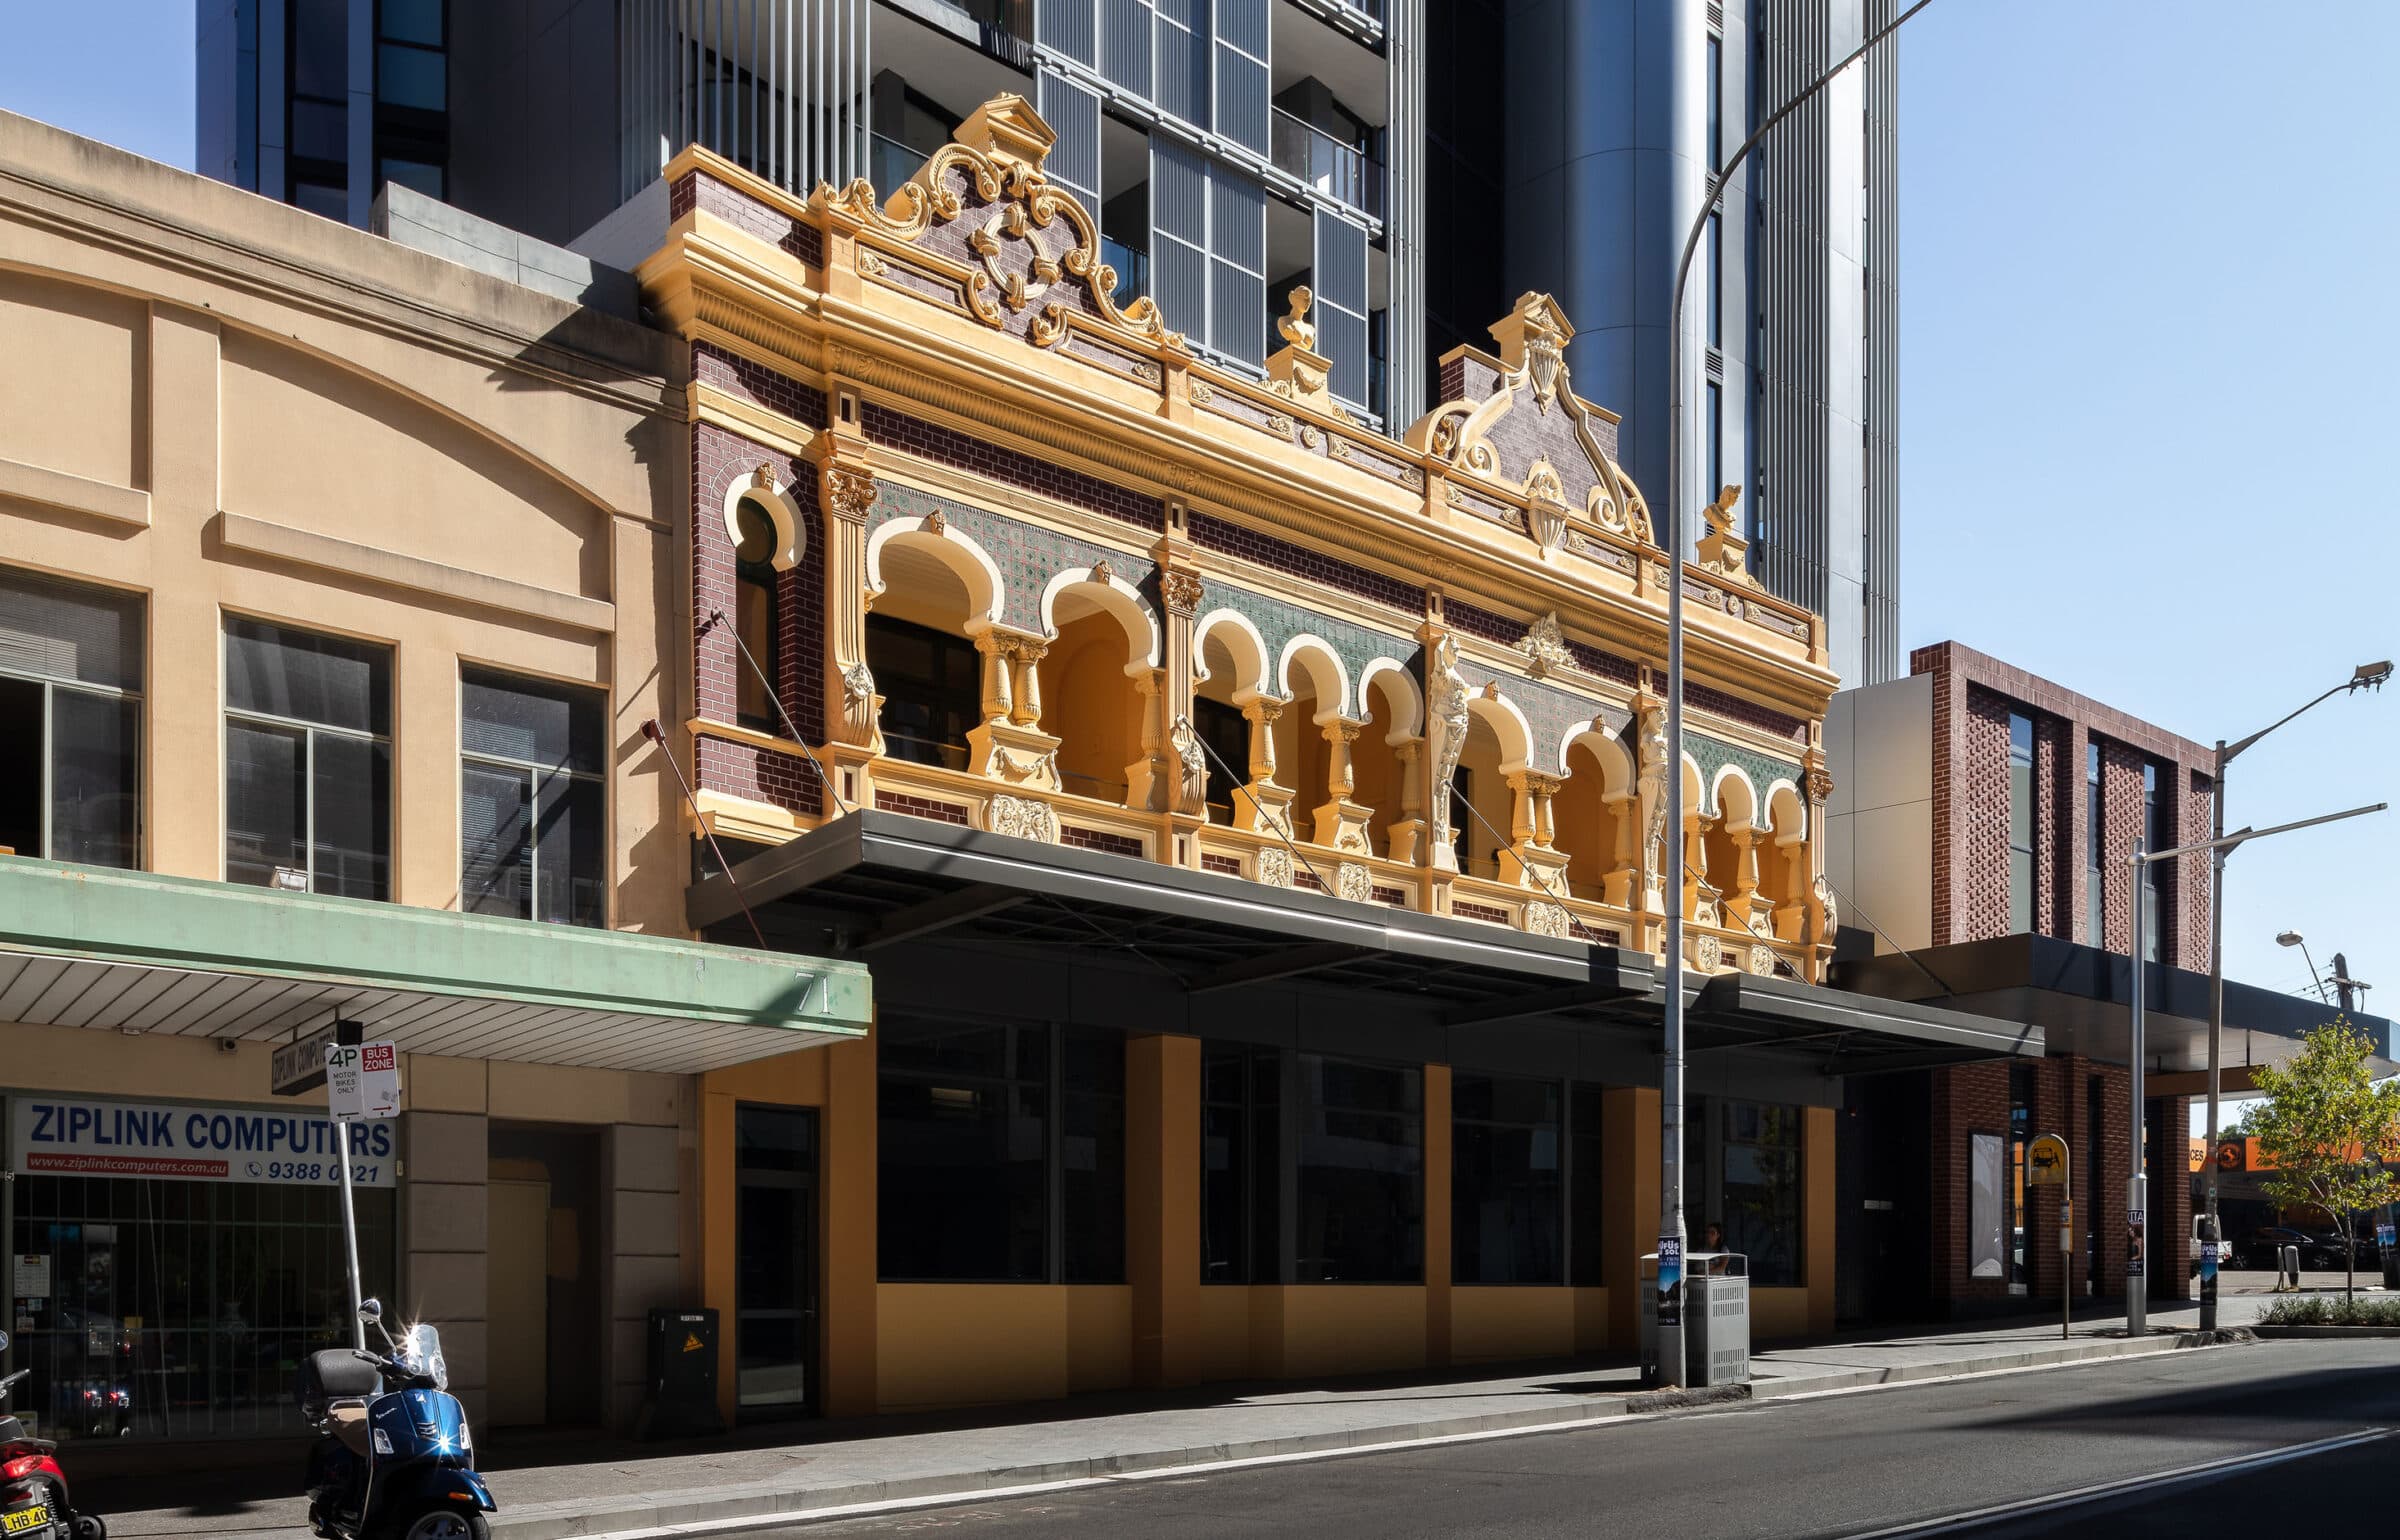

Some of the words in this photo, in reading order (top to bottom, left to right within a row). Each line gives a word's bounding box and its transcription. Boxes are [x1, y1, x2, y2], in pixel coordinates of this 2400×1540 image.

[795, 971, 833, 1014] 71
[329, 1049, 357, 1067] 4P
[366, 1048, 388, 1059] BUS
[364, 1059, 393, 1070] ZONE
[31, 1105, 174, 1147] ZIPLINK
[30, 1157, 227, 1174] www.ziplinkcomputers.com.au
[268, 1162, 321, 1180] 9388
[328, 1164, 378, 1182] 021
